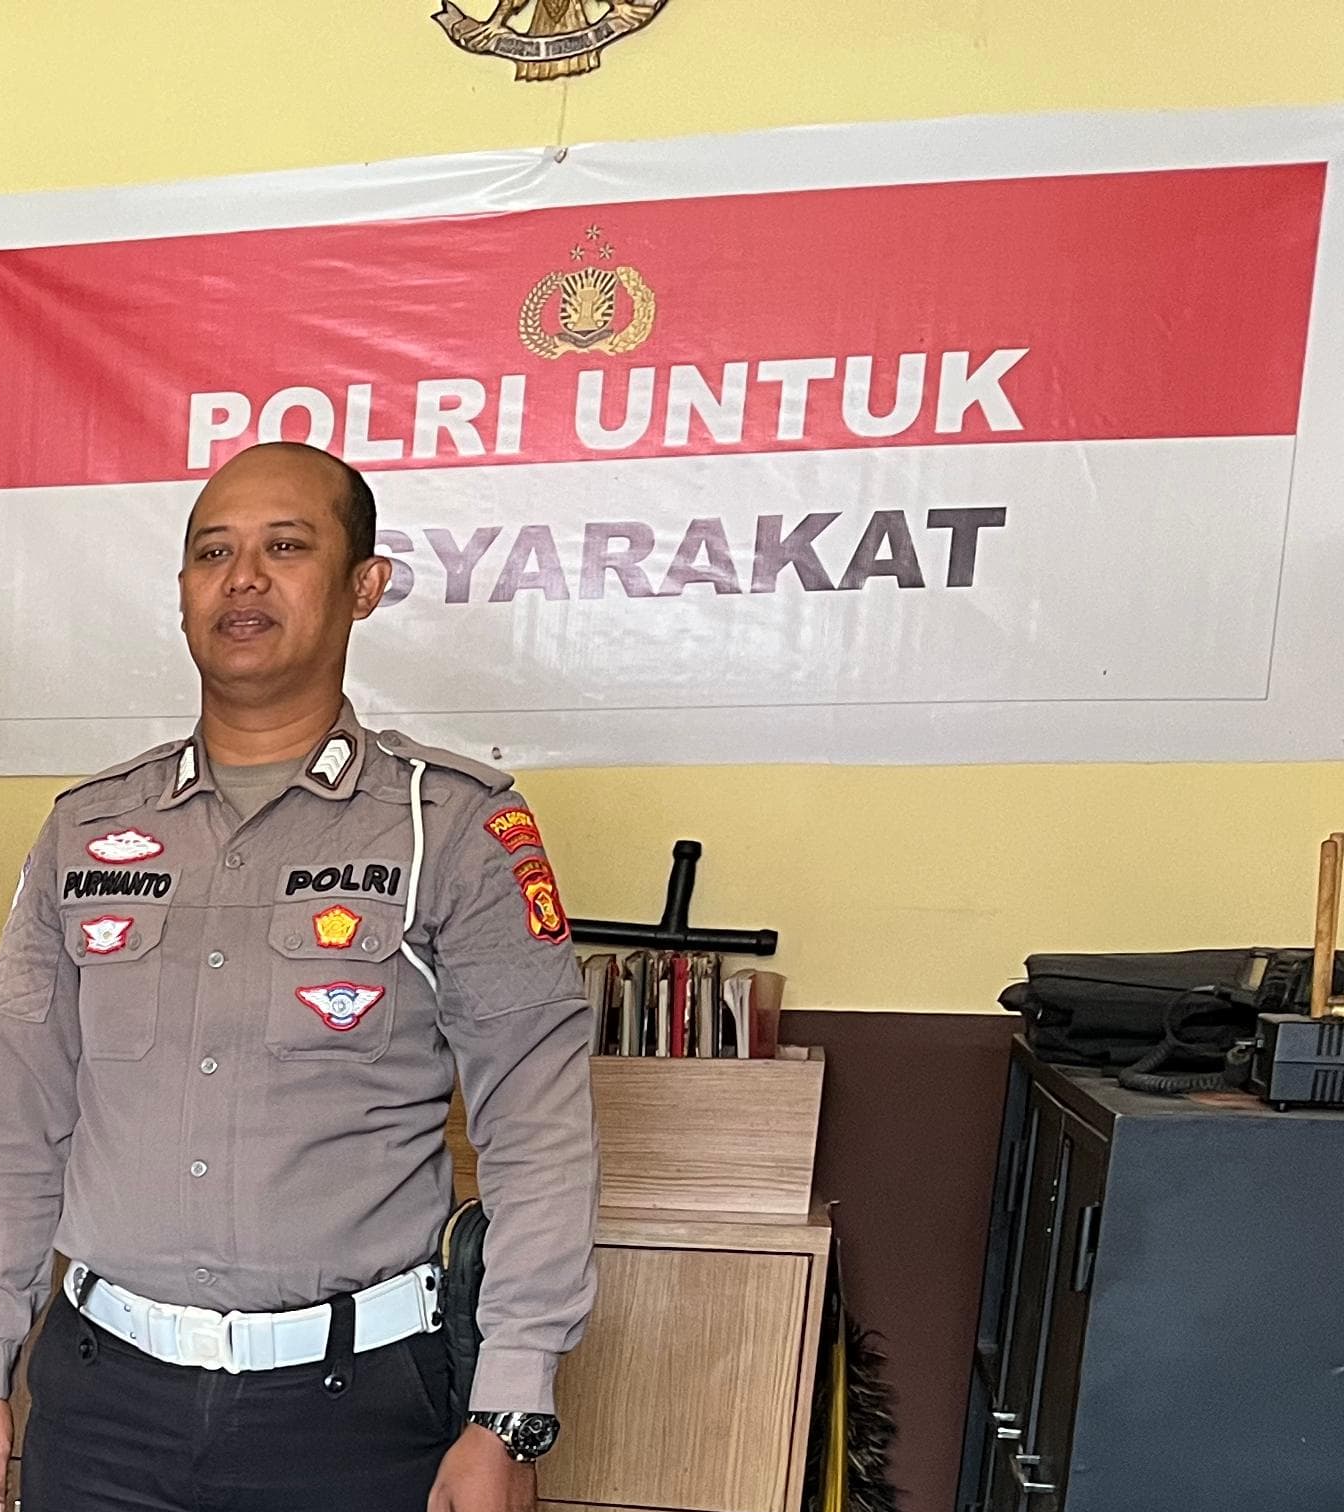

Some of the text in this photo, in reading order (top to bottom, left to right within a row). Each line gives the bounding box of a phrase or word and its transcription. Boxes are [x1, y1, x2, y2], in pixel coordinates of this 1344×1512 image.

[186, 348, 1030, 471] POLRI UNTUK
[372, 507, 1007, 611] SYARAKAT
[63, 869, 172, 900] PURWANTO
[285, 864, 402, 896] POLRI
